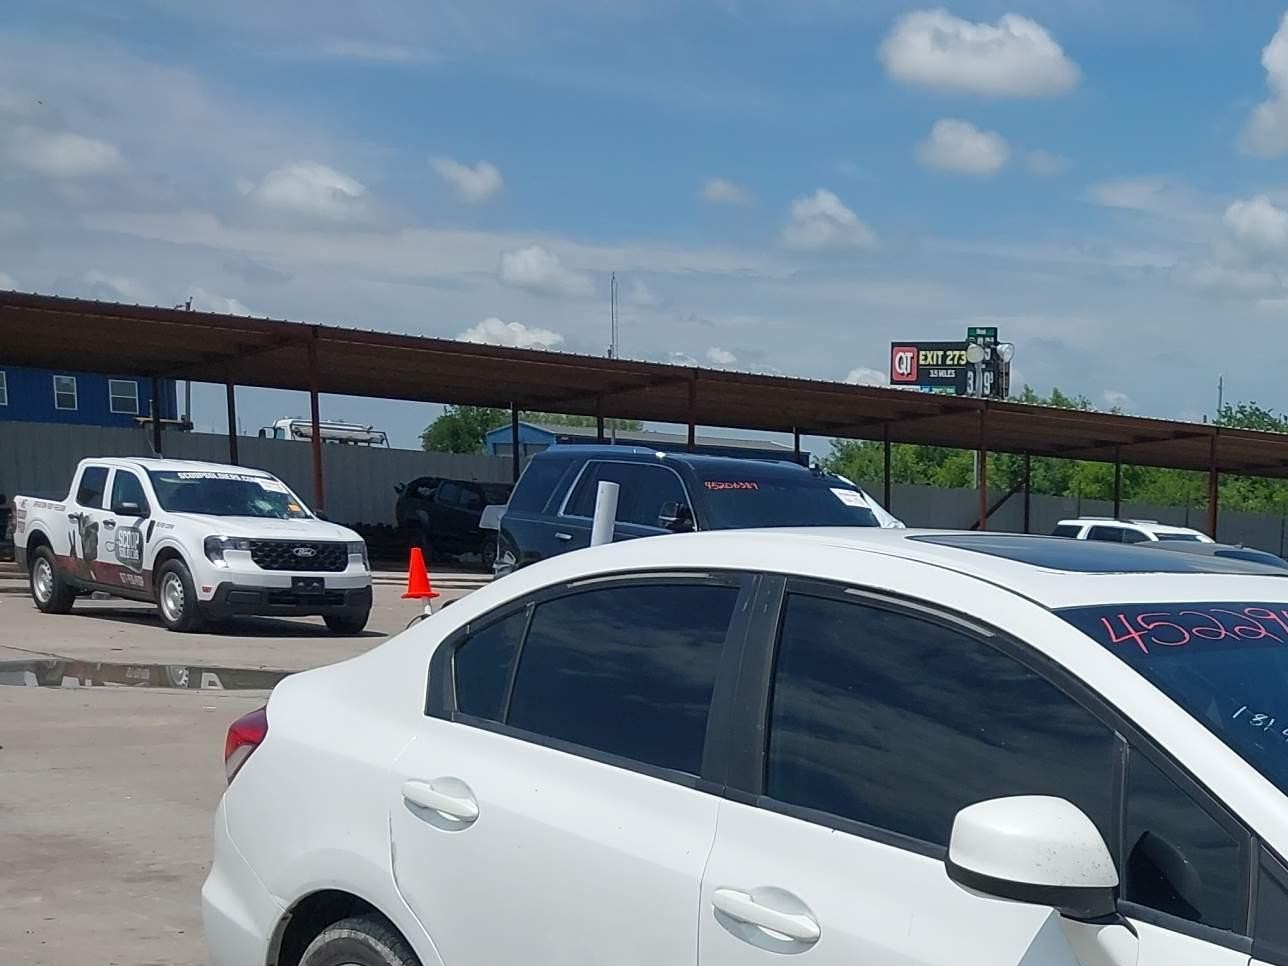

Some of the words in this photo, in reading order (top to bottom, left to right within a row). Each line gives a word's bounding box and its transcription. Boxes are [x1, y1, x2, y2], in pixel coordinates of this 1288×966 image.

[895, 352, 913, 377] QT
[919, 350, 944, 365] EXIT
[945, 350, 967, 365] 273
[118, 530, 139, 549] SCOOP
[297, 548, 315, 557] Ford
